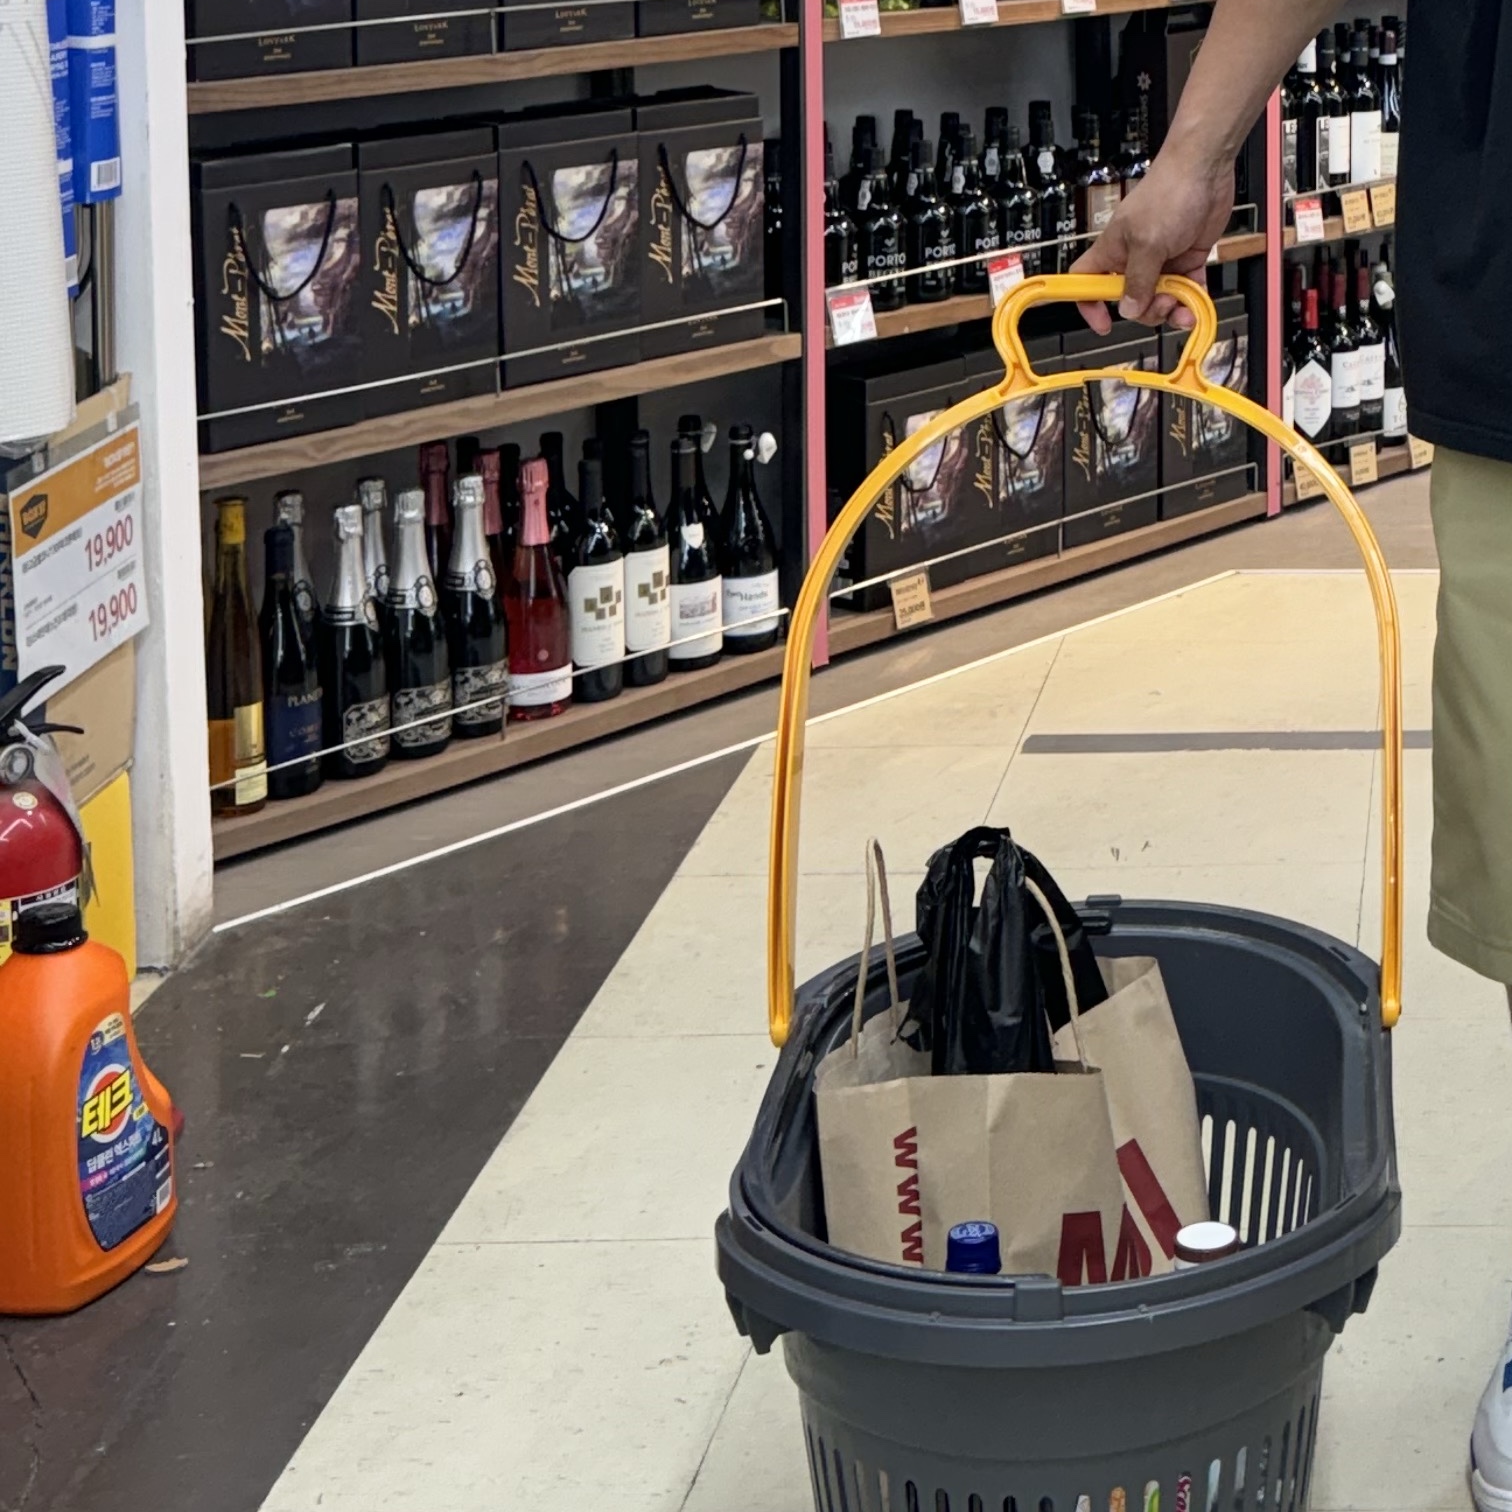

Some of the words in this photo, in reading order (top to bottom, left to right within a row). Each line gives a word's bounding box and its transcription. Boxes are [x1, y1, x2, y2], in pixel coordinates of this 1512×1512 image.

[867, 254, 907, 269] PORTO
[1006, 227, 1042, 244] PORTO
[84, 513, 134, 572] 19,900
[88, 581, 138, 642] 19,900
[81, 1066, 134, 1138] 테크
